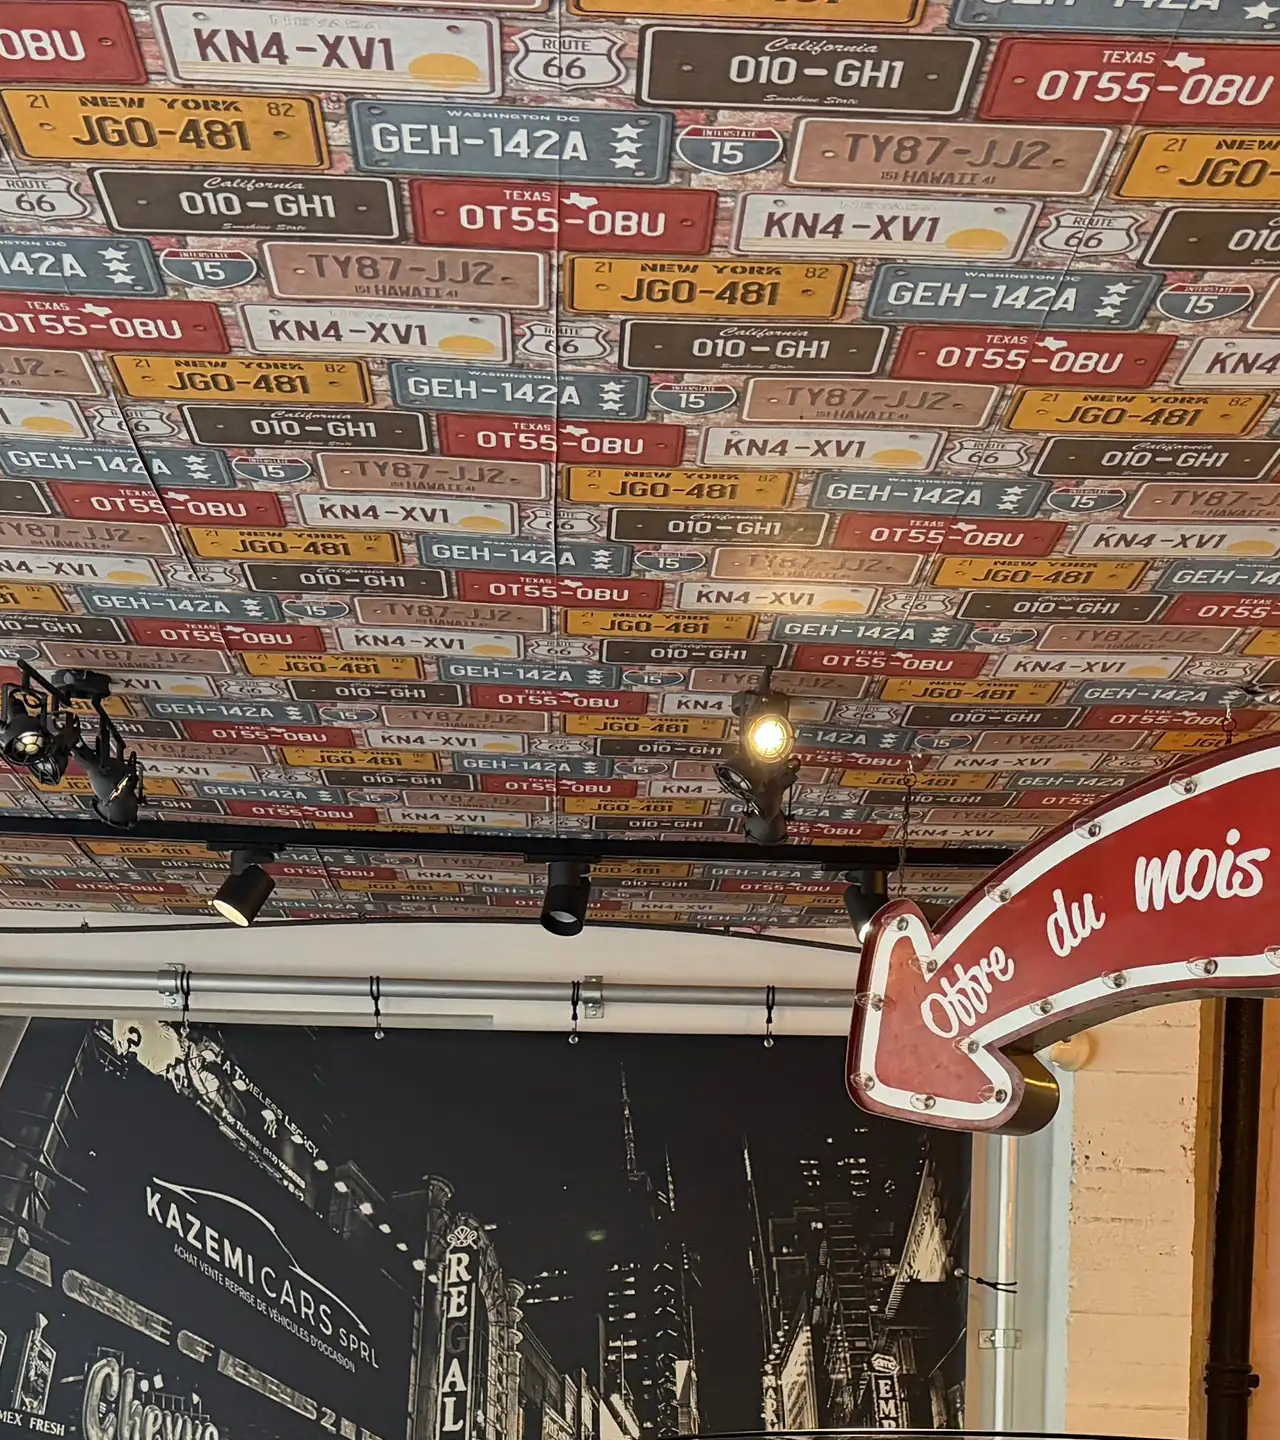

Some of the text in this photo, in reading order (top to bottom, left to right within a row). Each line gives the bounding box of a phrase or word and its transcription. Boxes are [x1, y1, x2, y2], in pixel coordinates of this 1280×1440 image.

[542, 36, 590, 51] ROUTE
[1097, 48, 1158, 64] TEXAS
[541, 55, 586, 80] 66
[76, 94, 148, 108] NEW
[159, 98, 243, 112] YORK
[267, 103, 297, 117] 82
[369, 122, 589, 161] GEH-142A
[709, 141, 746, 165] 15
[3, 178, 51, 190] ROUTE
[14, 193, 55, 212] 66
[502, 189, 552, 202] TEXAS
[1070, 216, 1116, 227] ROUTE
[1062, 230, 1102, 249] 66
[885, 281, 1075, 311] GEH-142A
[824, 484, 980, 505] GEH-142A
[921, 829, 1271, 1040] Offre du mois
[174, 1244, 197, 1267] ACHAT
[199, 1262, 223, 1285] VENTE
[225, 1277, 256, 1307] REPRISE
[256, 1299, 268, 1315] DE
[260, 1266, 333, 1336] CARS
[339, 1328, 379, 1369] SPRL
[440, 1252, 471, 1433] REGAL
[29, 1417, 65, 1436] FRESH
